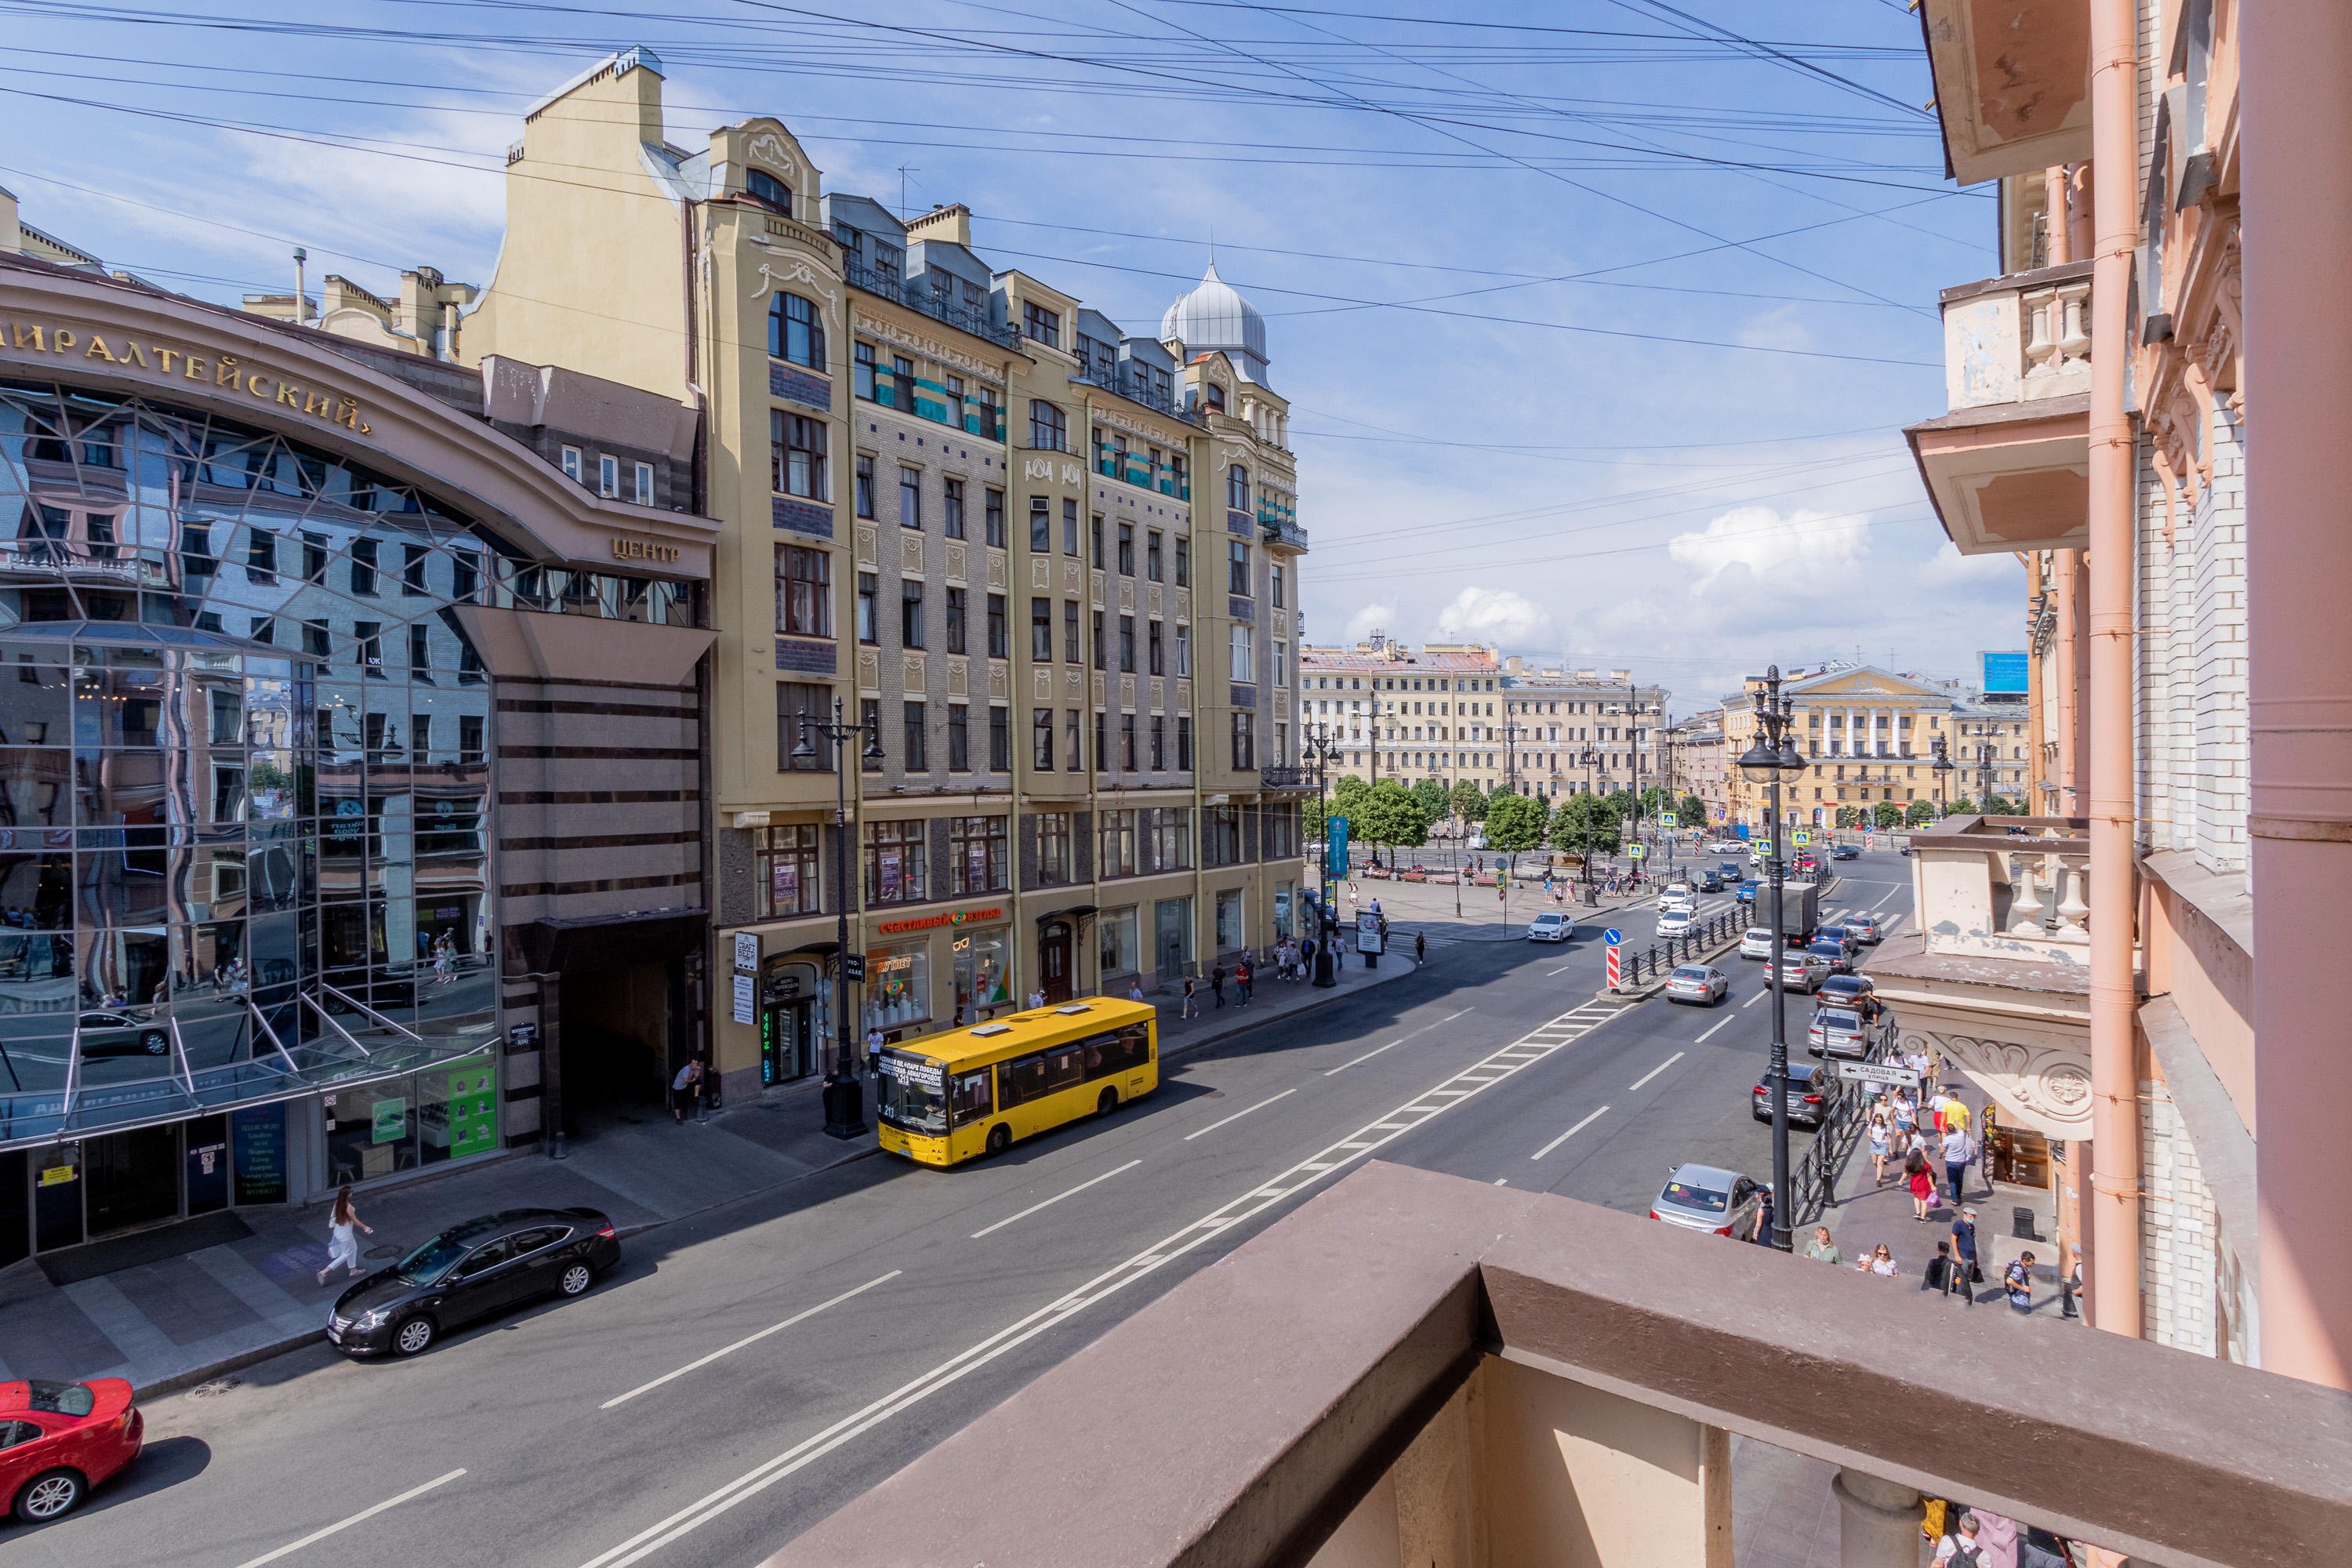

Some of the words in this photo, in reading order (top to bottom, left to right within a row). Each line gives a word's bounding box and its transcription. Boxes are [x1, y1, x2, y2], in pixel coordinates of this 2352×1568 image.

[0, 321, 372, 436] ИРАЛТЕЙСКИЙ»
[612, 537, 681, 563] ЦЕНТР
[967, 908, 1003, 921] взгляд
[738, 942, 756, 952] CRAFT
[738, 948, 756, 960] BEER
[848, 967, 862, 976] АБАК
[877, 956, 912, 974] АУТЛЕТ
[511, 1025, 535, 1034] МОСКОВСКИЙ
[882, 1055, 897, 1065] СЕННАЯ
[906, 1062, 920, 1071] ПАРК
[920, 1065, 942, 1076] ПОБЕДЫ
[906, 1069, 942, 1082] АВИАГОРОДОК
[1860, 1066, 1897, 1076] САДОВАЯ
[884, 1105, 895, 1120] 213
